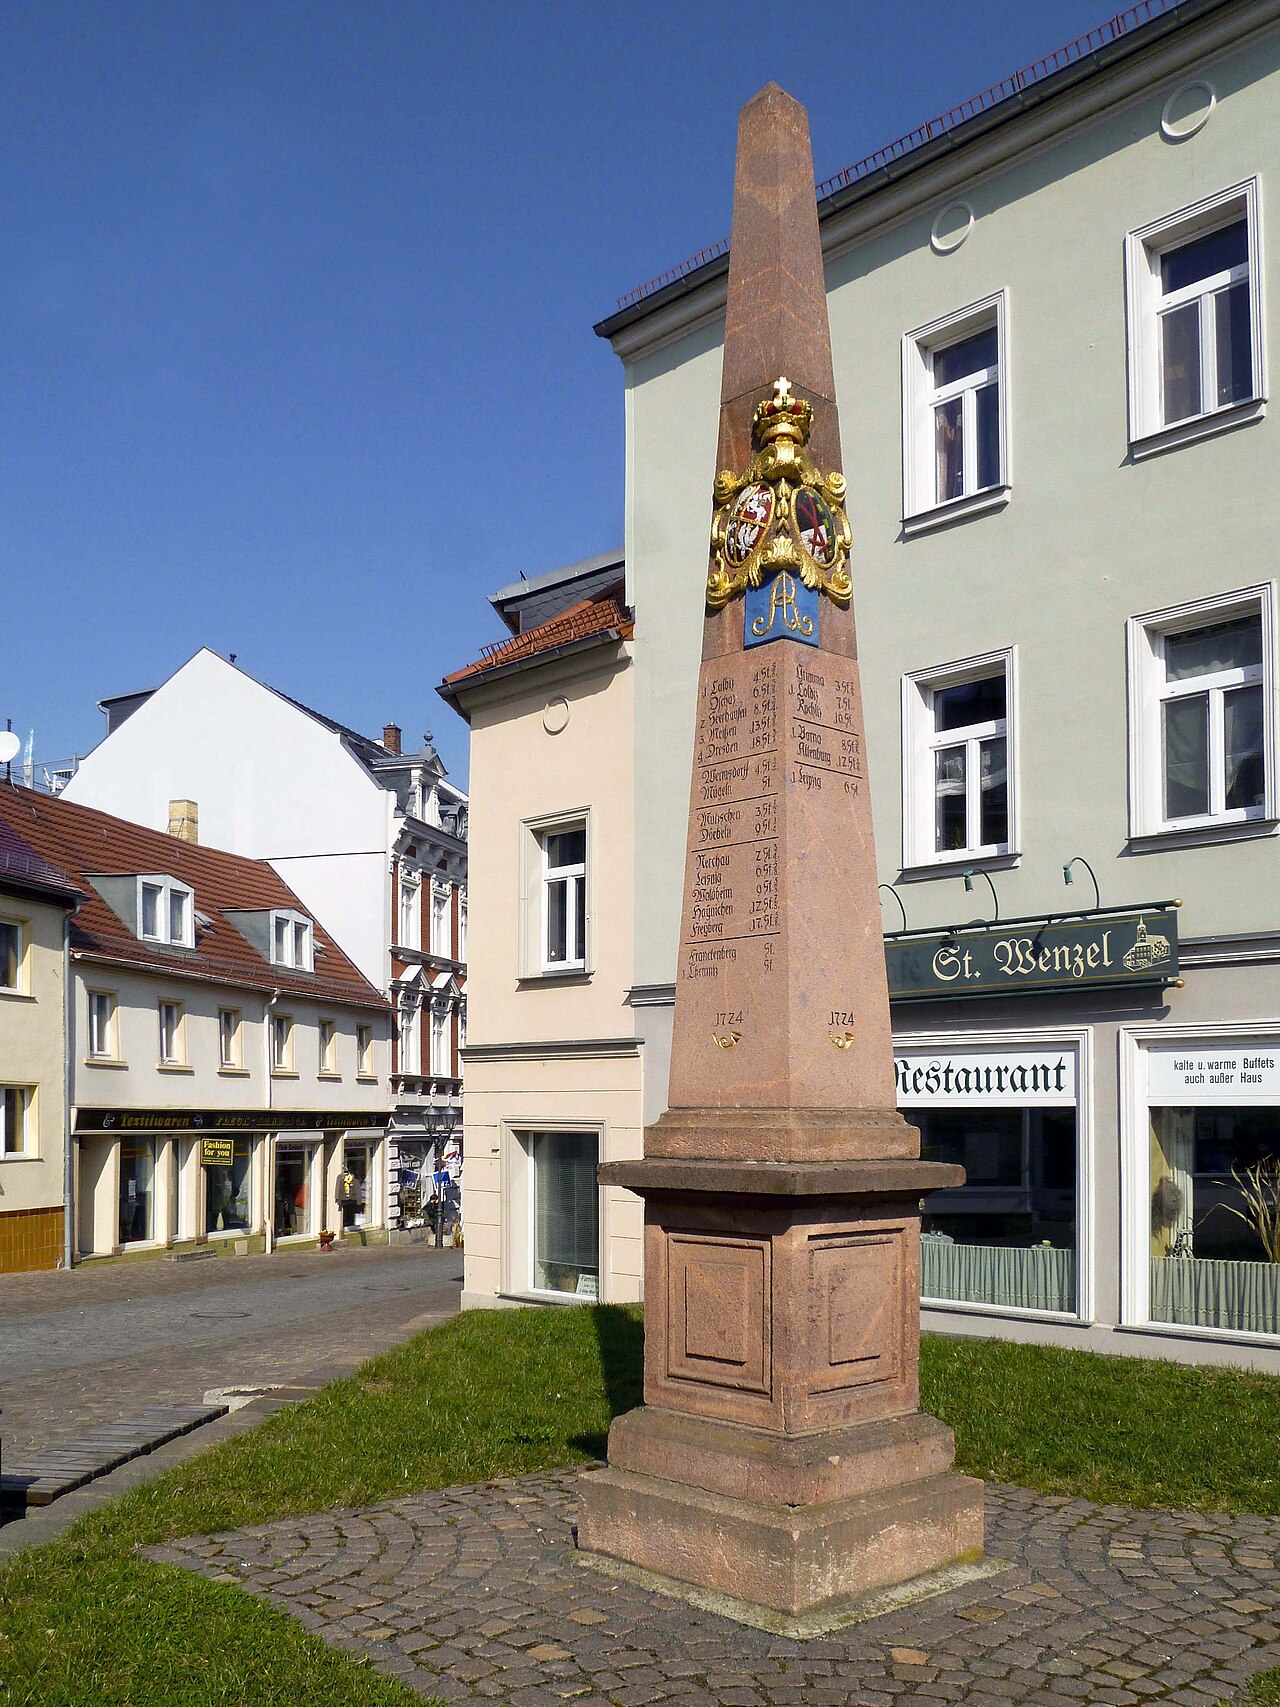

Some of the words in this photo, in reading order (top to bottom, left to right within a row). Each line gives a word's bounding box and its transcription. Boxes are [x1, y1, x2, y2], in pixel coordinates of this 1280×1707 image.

[705, 742, 738, 758] Dresden
[932, 945, 981, 981] St.
[994, 930, 1114, 978] Wenzel
[713, 1011, 744, 1027] 1724
[828, 1011, 855, 1027] 1724
[1173, 1060, 1194, 1071] kalte
[1198, 1062, 1206, 1070] u.
[1207, 1060, 1237, 1070] warme
[1243, 1058, 1275, 1069] Buffets
[1184, 1073, 1205, 1084] auch
[1209, 1073, 1234, 1084] außer
[1240, 1072, 1263, 1083] Haus
[120, 1113, 190, 1128] Textilwaren
[203, 1140, 231, 1150] Fashion
[204, 1148, 215, 1156] for
[216, 1150, 230, 1158] you
